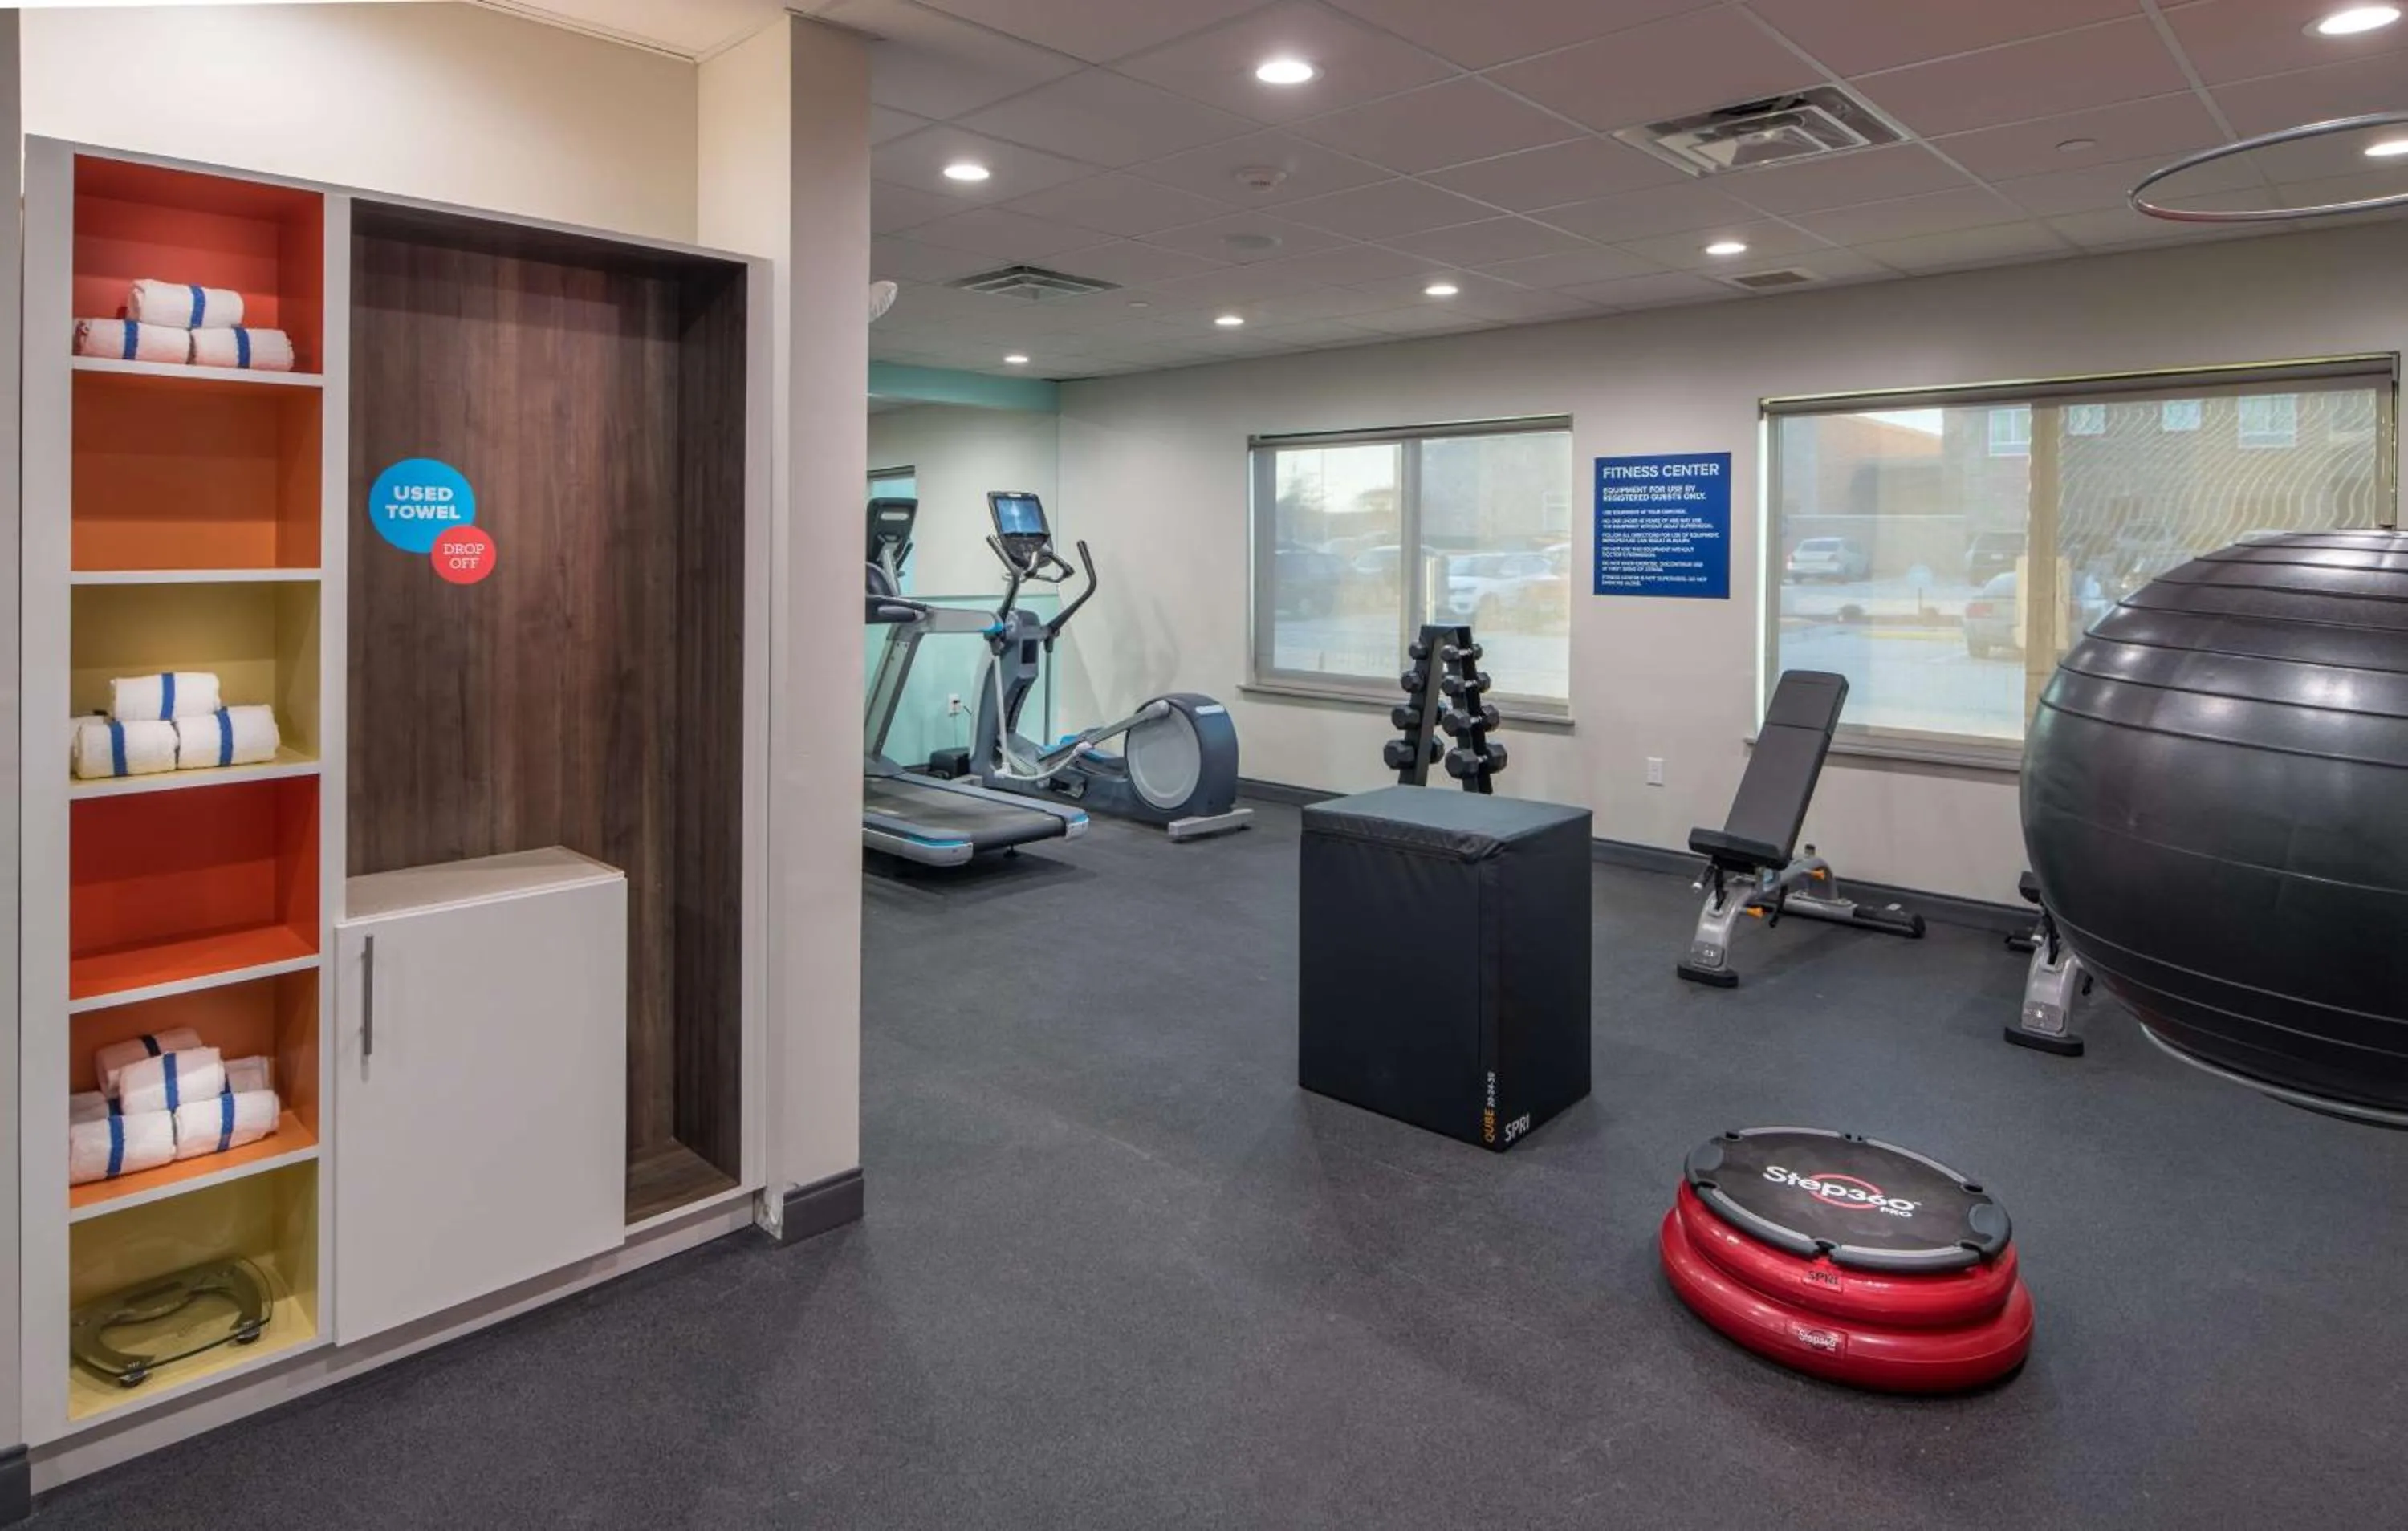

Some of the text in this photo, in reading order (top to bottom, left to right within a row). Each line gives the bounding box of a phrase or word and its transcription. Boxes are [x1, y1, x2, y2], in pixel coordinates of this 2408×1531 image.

[1603, 463, 1719, 479] FITNESS CENTER
[393, 485, 454, 502] USED
[1603, 491, 1706, 502] REGISTERED GUESTS ONLY.
[385, 505, 461, 520] TOWEL
[443, 543, 485, 554] DROP
[449, 558, 479, 569] OFF
[1484, 1107, 1495, 1143] QUBE
[1505, 1112, 1530, 1142] SPRI
[1880, 1207, 1913, 1217] PRO
[1808, 1270, 1838, 1285] SPRI
